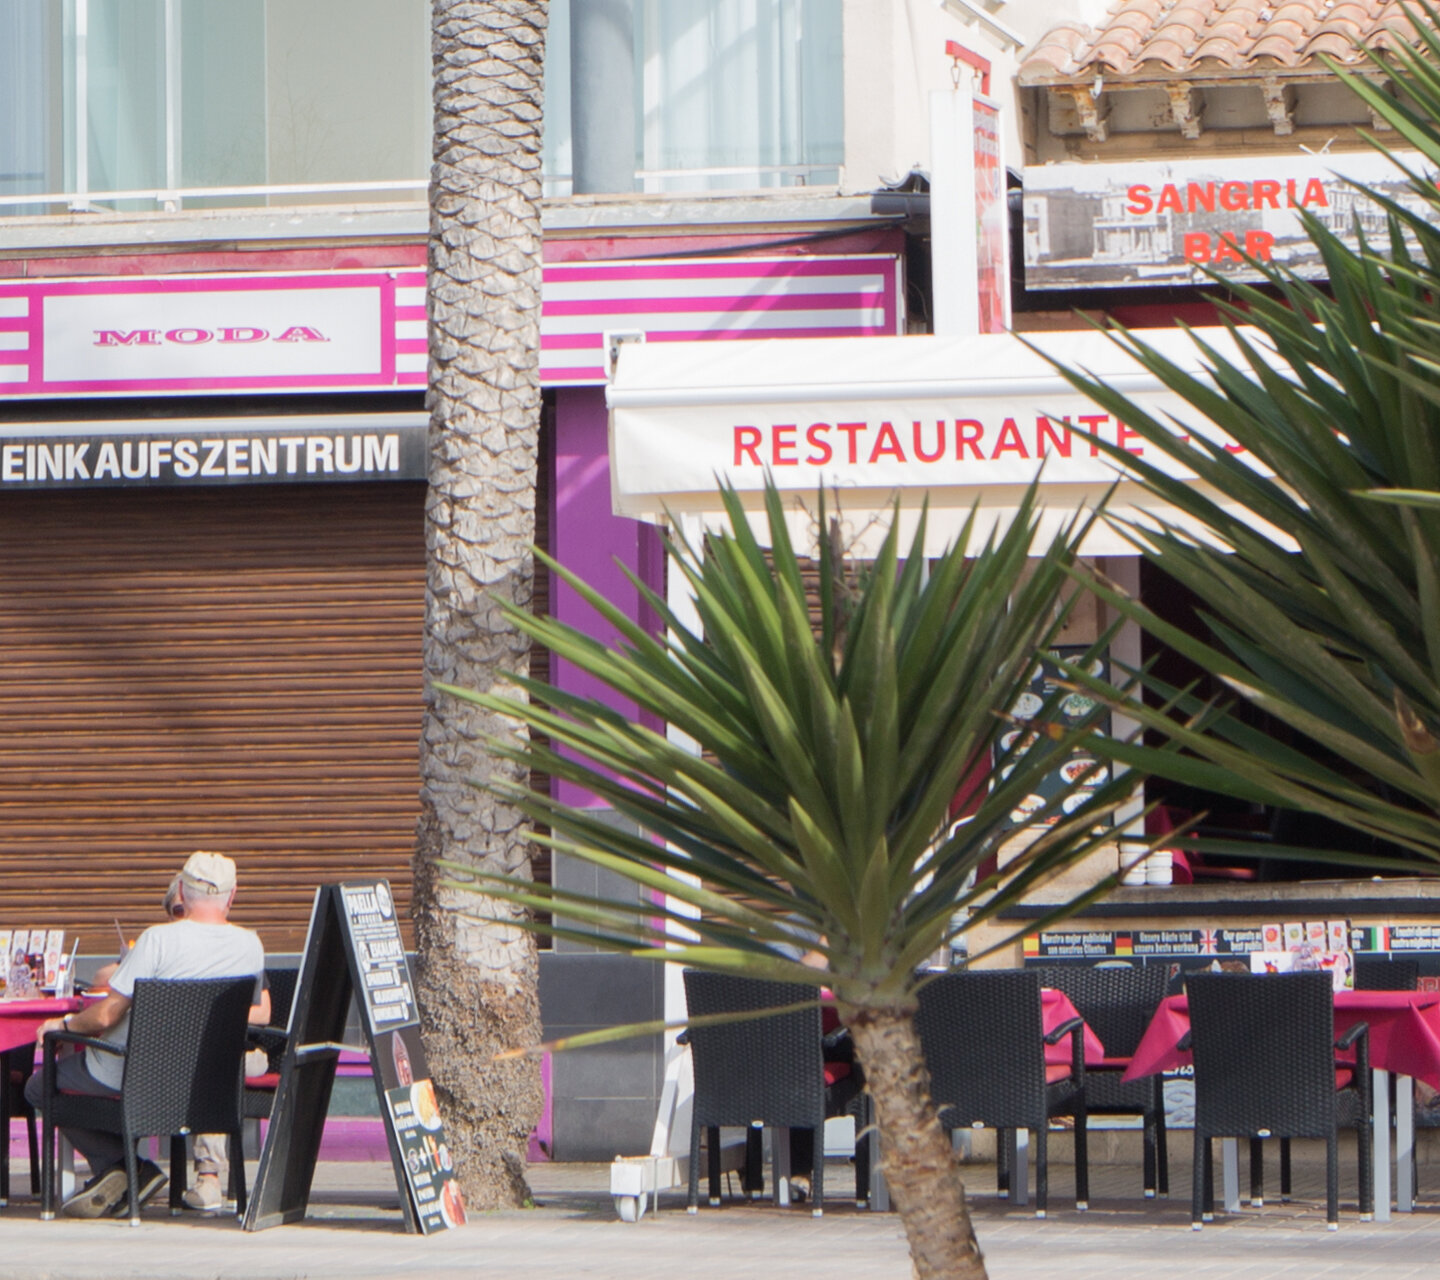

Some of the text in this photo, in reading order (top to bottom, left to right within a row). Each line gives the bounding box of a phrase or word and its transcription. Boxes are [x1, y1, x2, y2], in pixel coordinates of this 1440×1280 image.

[1125, 177, 1329, 215] SANGRIA
[1183, 229, 1276, 264] BAR
[92, 326, 330, 348] MODA
[733, 412, 1145, 467] RESTAURANTE
[1, 434, 401, 482] EINKAUFSZENTRUM
[346, 892, 381, 915] PAELLA
